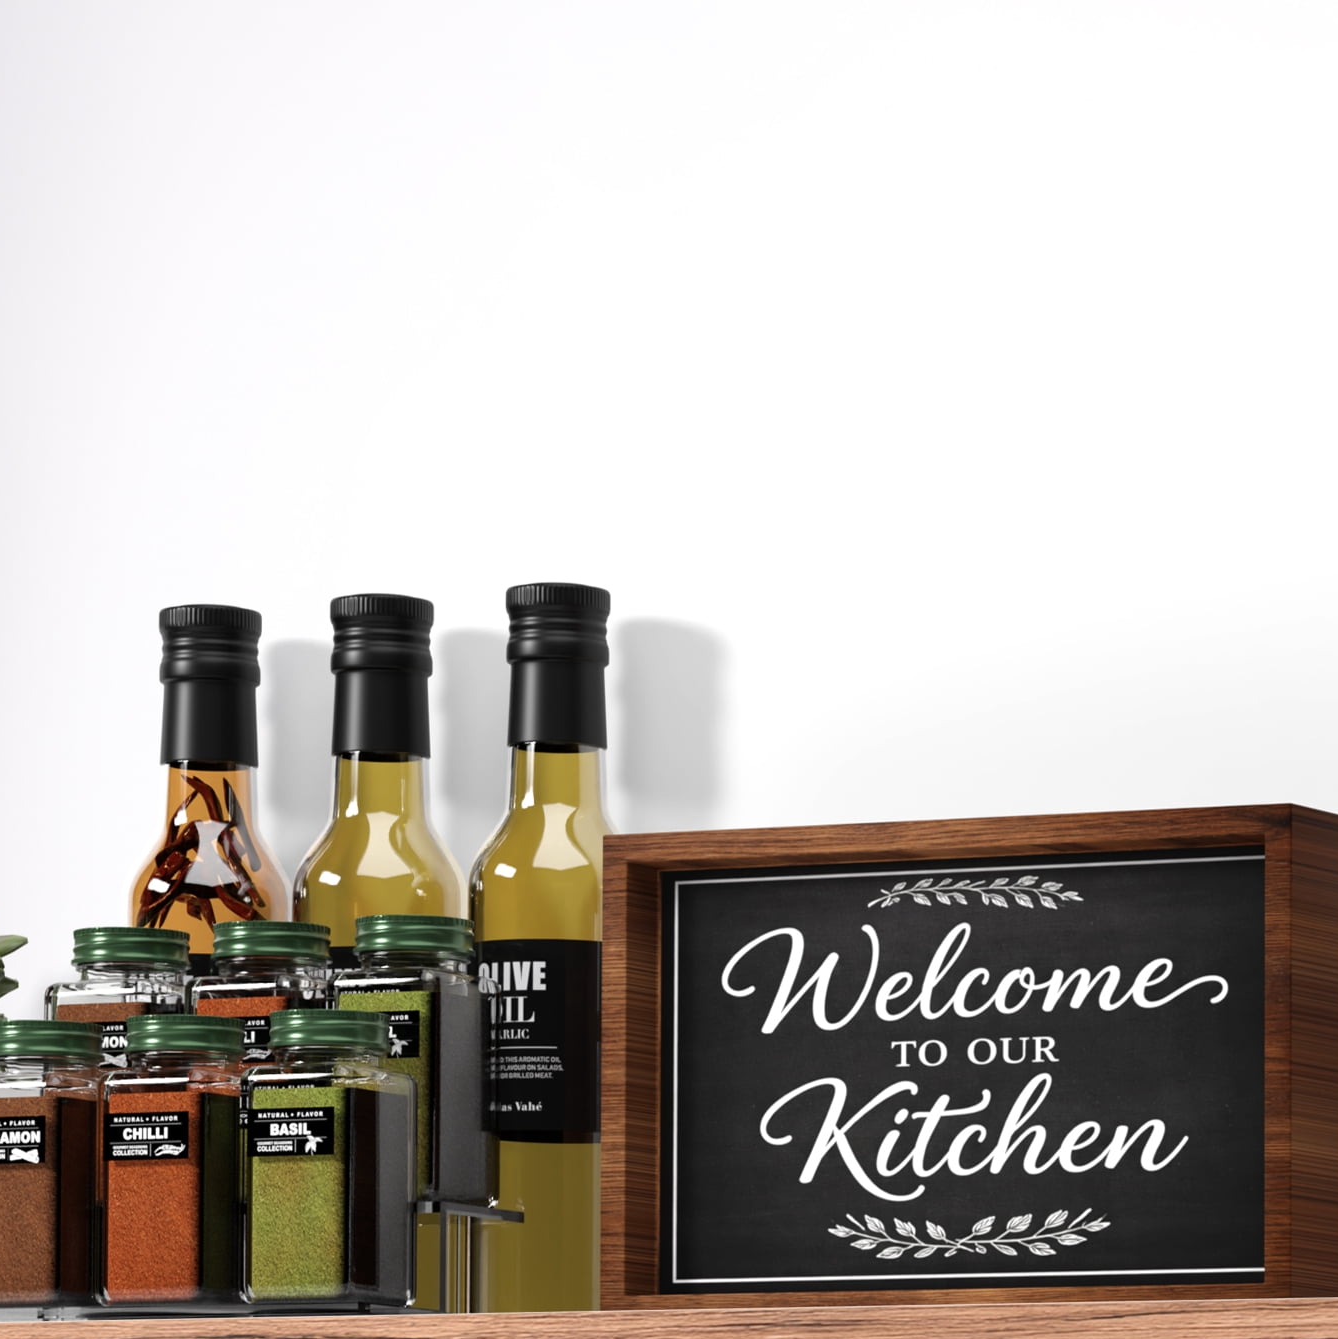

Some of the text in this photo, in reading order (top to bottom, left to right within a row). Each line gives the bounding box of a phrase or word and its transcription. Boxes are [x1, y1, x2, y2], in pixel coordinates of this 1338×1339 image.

[720, 921, 1230, 1035] Welcome
[102, 1024, 124, 1032] LAVOR
[890, 1035, 1060, 1069] TO OUR
[515, 1100, 543, 1112] Vahé
[296, 1110, 324, 1118] FLAVOR
[9, 1119, 36, 1127] FLAVOR
[122, 1126, 169, 1141] CHILLI
[269, 1122, 312, 1137] BASIL
[759, 1072, 1190, 1204] Kitchen
[112, 1149, 148, 1157] COLLECTION
[256, 1145, 293, 1153] COLLECTION
